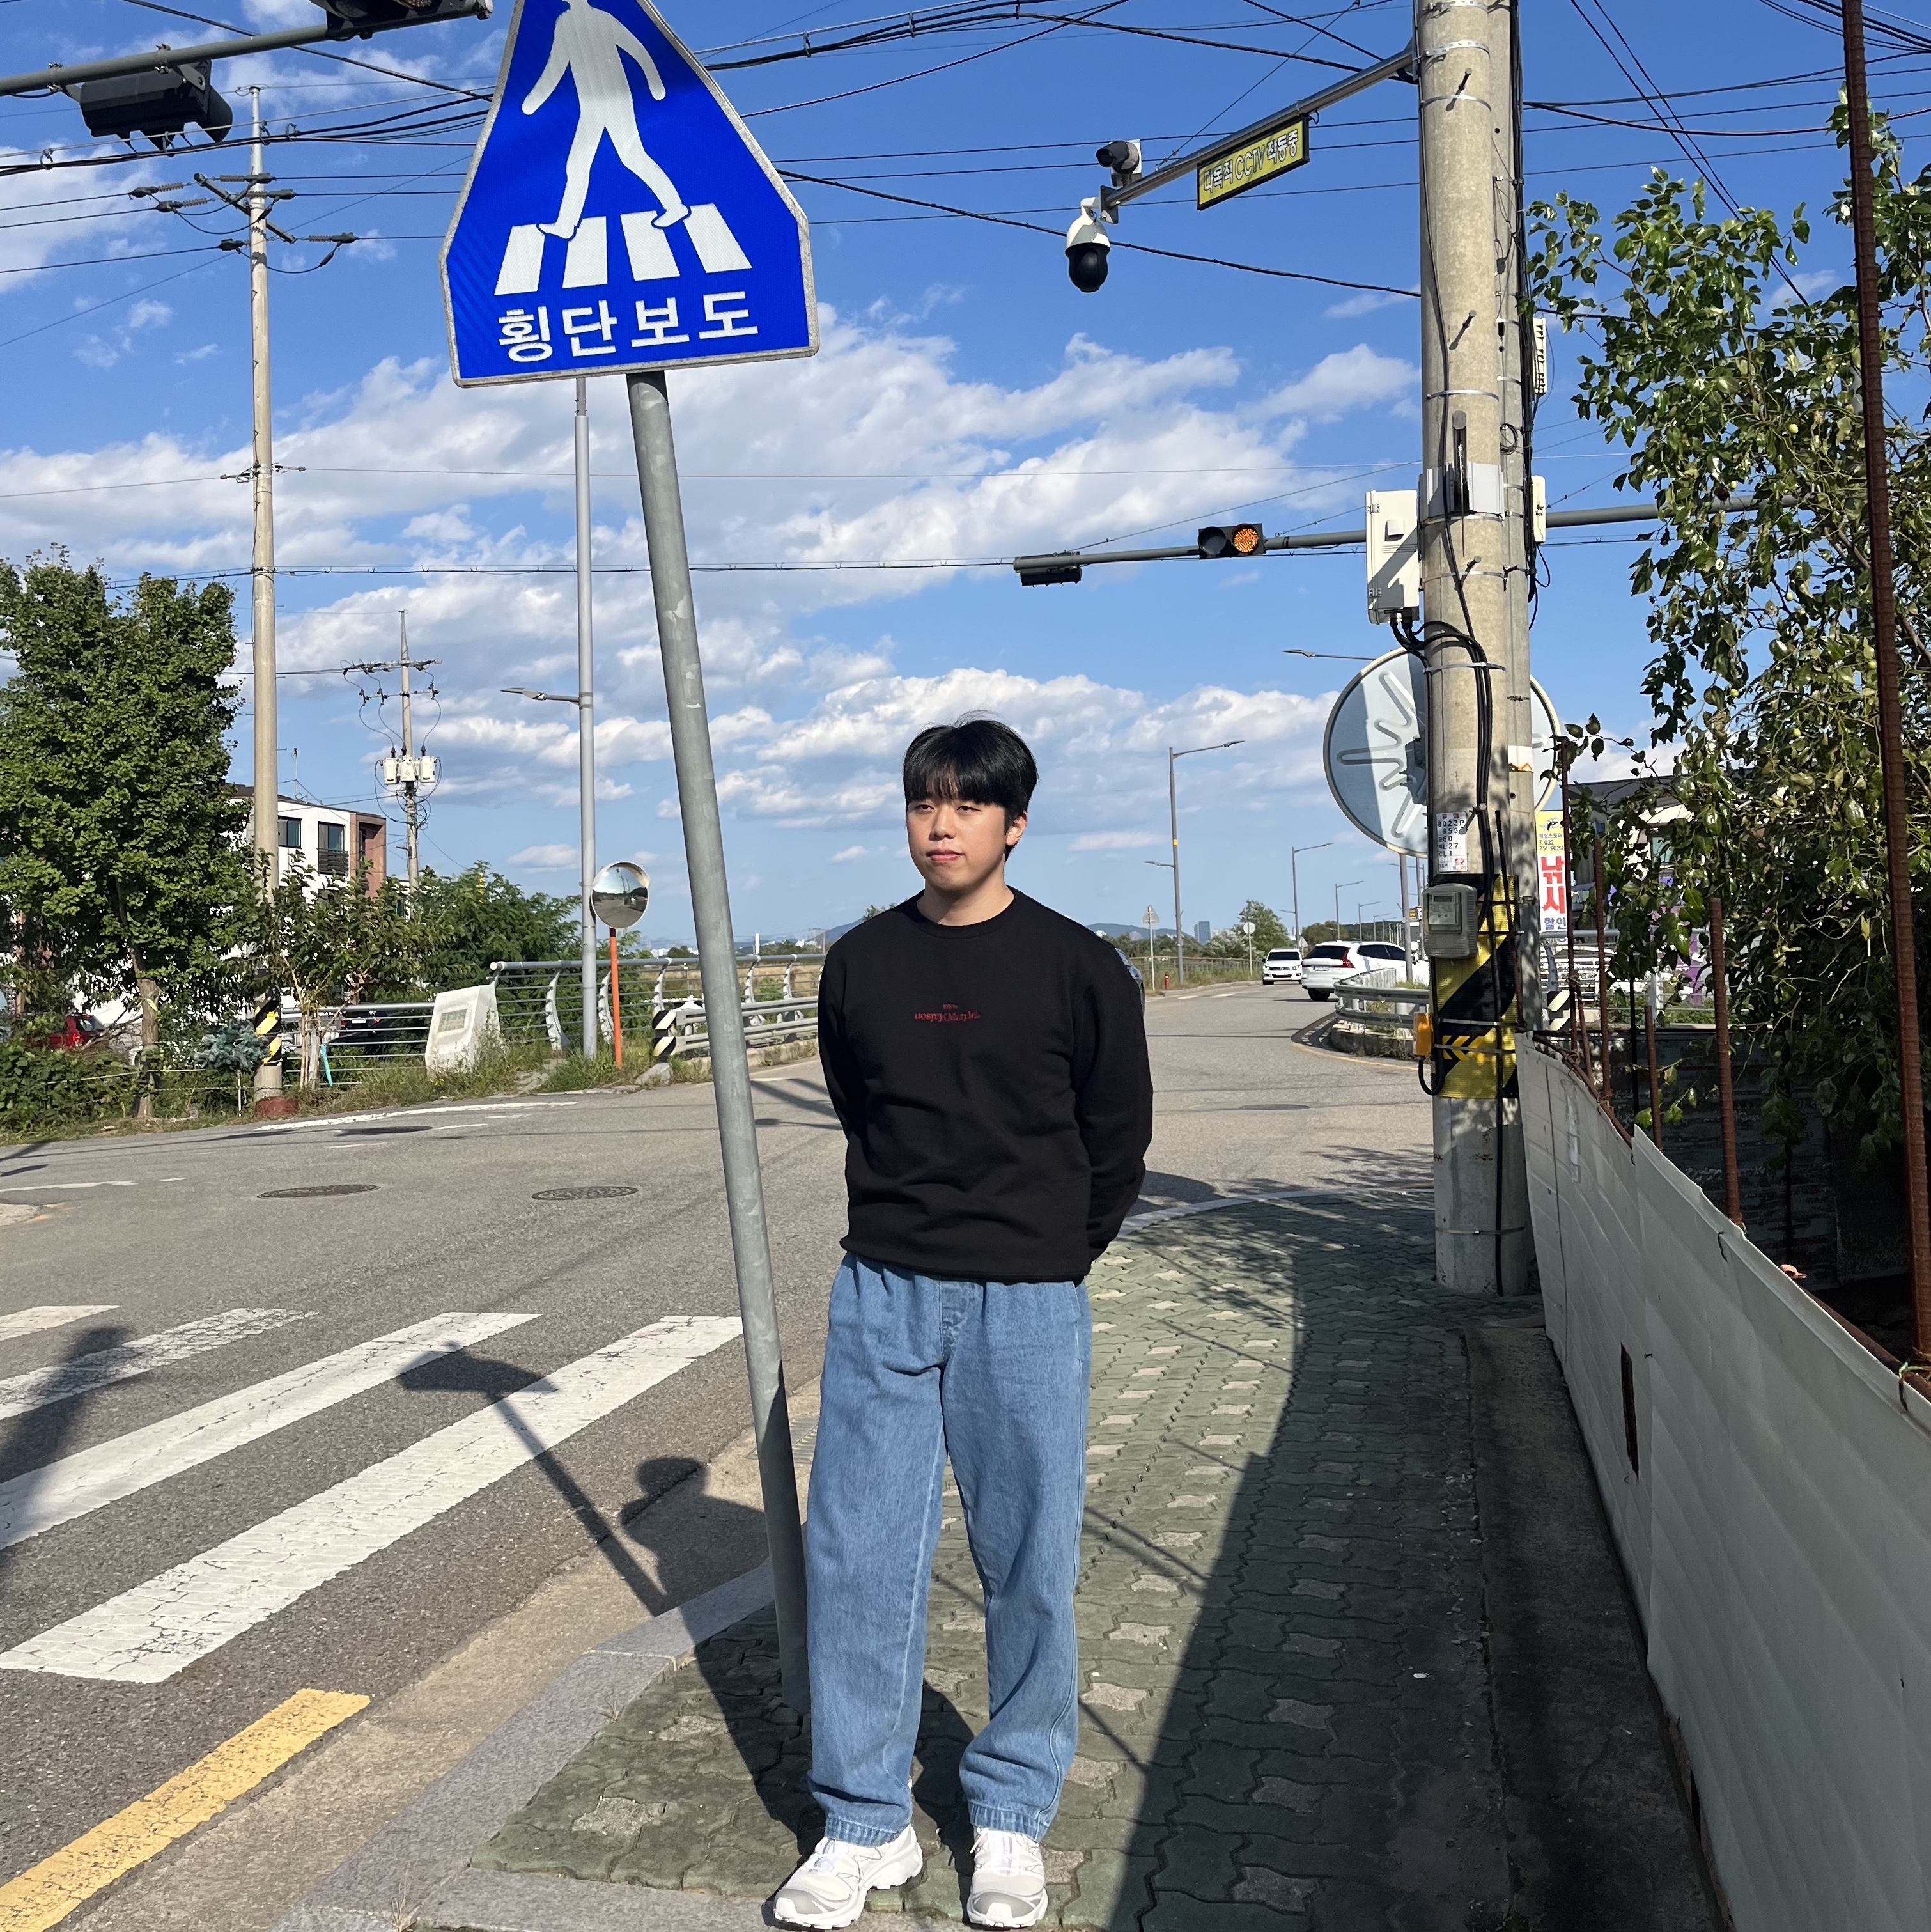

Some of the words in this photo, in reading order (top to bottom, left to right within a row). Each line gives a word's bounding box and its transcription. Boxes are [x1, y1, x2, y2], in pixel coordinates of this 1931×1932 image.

[1204, 159, 1233, 193] 다목적
[1235, 144, 1265, 180] CCTV
[1267, 129, 1298, 164] 작동중
[498, 291, 759, 362] 횡단보도
[1541, 856, 1565, 914] 낚시
[1544, 917, 1567, 930] 할인
